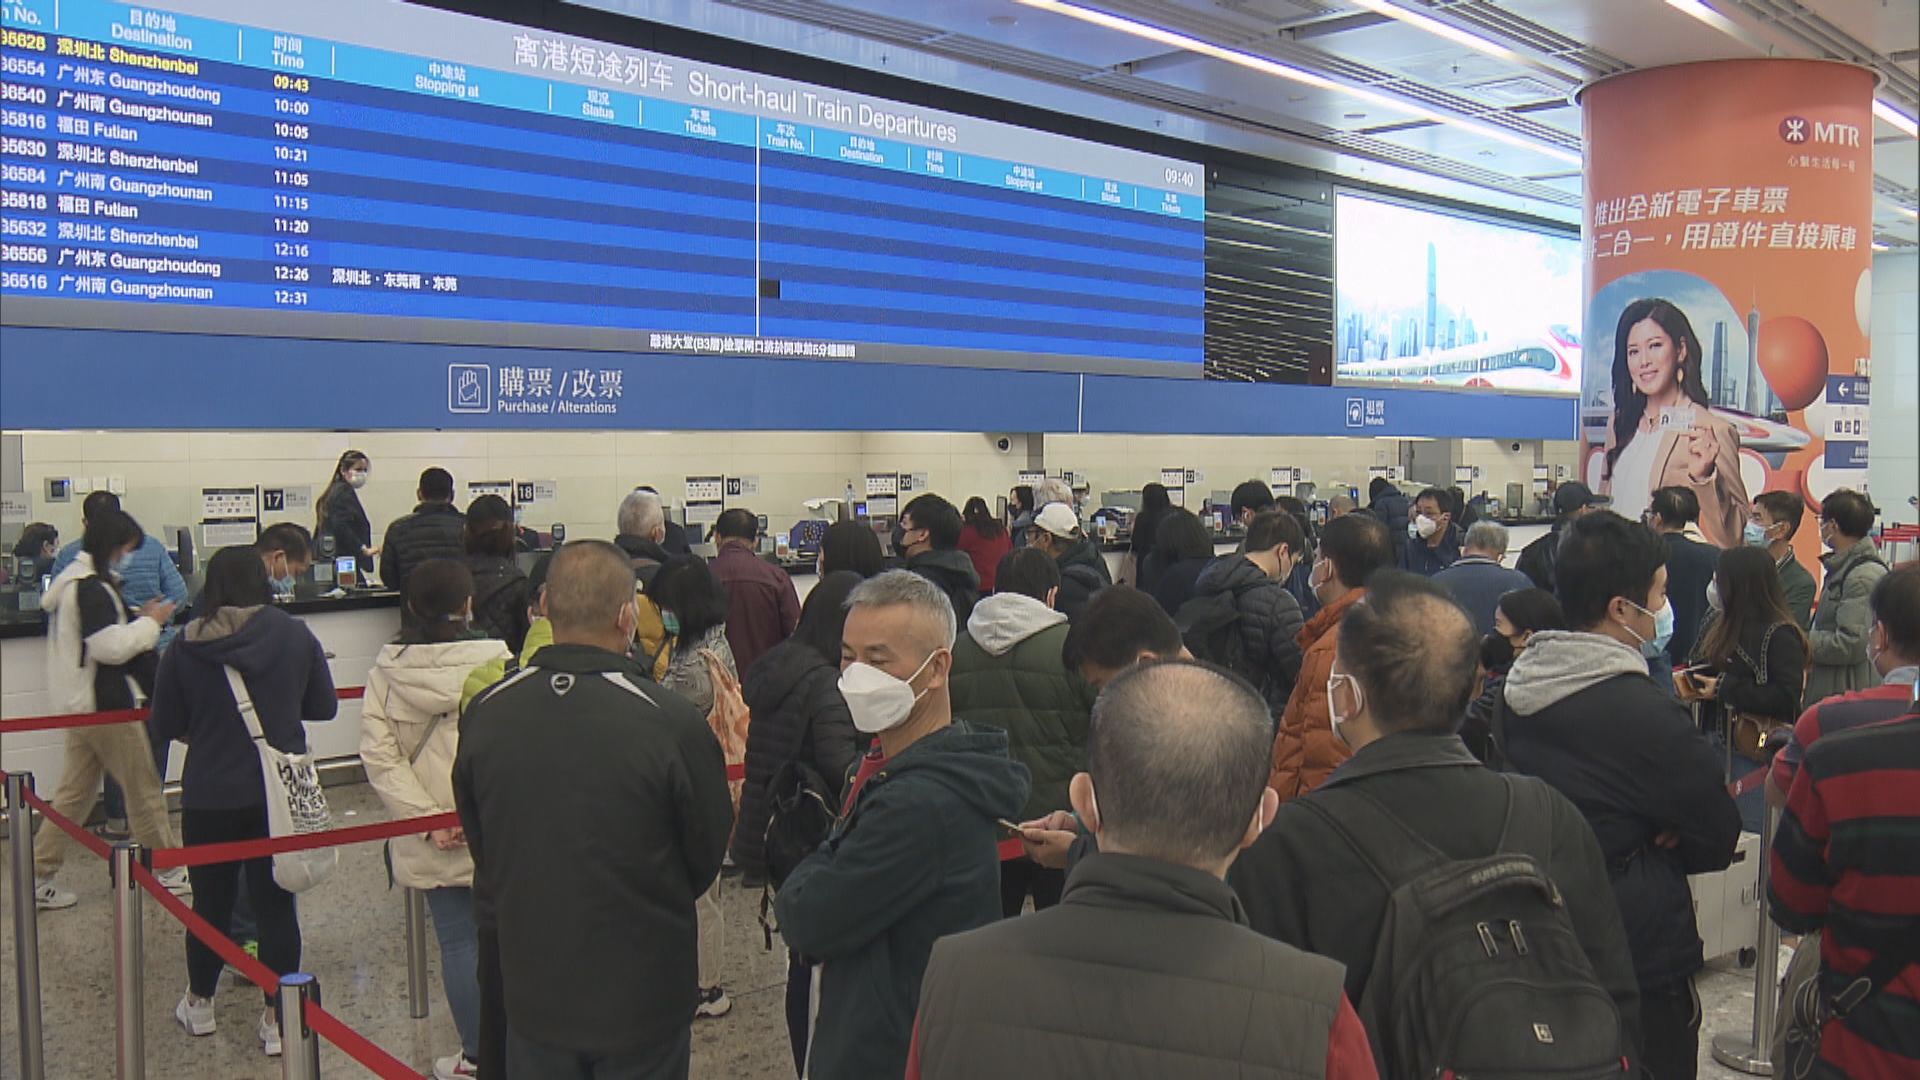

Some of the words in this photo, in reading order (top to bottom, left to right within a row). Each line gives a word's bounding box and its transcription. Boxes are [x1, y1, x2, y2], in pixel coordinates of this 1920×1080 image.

[14, 7, 42, 26] No.
[130, 9, 176, 33] 目的地
[111, 22, 192, 51] Destination
[273, 34, 303, 55] 时间
[57, 37, 105, 61] 深圳北
[109, 48, 198, 75] Shenzhenbei
[273, 74, 309, 93] 09:43
[271, 49, 305, 70] Time
[57, 63, 106, 86] 广州东
[109, 72, 221, 105] Guangzhoudong
[274, 98, 309, 116] 10:00
[415, 73, 466, 98] Stopping
[467, 84, 479, 98] at
[512, 32, 673, 92] 离港短途列车
[687, 70, 797, 115] Short-haul
[804, 90, 853, 124] Train
[858, 105, 957, 144] Departures
[57, 90, 106, 114] 广州南
[109, 98, 213, 128] Guangzhounan
[274, 122, 309, 140] 10:05
[581, 101, 615, 121] Status
[57, 115, 90, 137] 福田
[94, 121, 138, 142] Futian
[274, 146, 308, 163] 10:21
[683, 119, 717, 138] Tickets
[1814, 121, 1860, 149] MTR
[766, 133, 788, 148] Train
[789, 138, 805, 151] No.
[57, 142, 105, 164] 深圳北
[109, 149, 198, 175] Shenzhenbei
[274, 169, 309, 187] 11:05
[840, 145, 884, 165] Destination
[926, 161, 945, 175] Time
[1164, 167, 1194, 188] 09:40
[57, 169, 106, 192] 广州南
[109, 175, 213, 202] Guangzhounan
[274, 194, 309, 211] 11:15
[57, 194, 90, 216] 福田
[94, 200, 138, 220] Futian
[274, 218, 309, 234] 11:20
[1594, 185, 1789, 228] 推出全新電子車票
[58, 221, 106, 242] 深圳北
[110, 226, 199, 250] Shenzhenbei
[274, 242, 309, 258] 12:16
[58, 247, 107, 268] 广州东
[110, 251, 221, 278] Guangzhoudong
[274, 265, 309, 282] 12:26
[58, 274, 107, 295] 广州南
[110, 278, 213, 300] Guangzhounan
[274, 289, 308, 306] 12:31
[498, 365, 623, 399] 購票/改票
[497, 399, 549, 414] Purchase
[558, 400, 617, 414] Alterations
[519, 486, 532, 499] 18
[728, 481, 740, 494] 19
[901, 478, 911, 488] 20
[265, 493, 282, 508] 17
